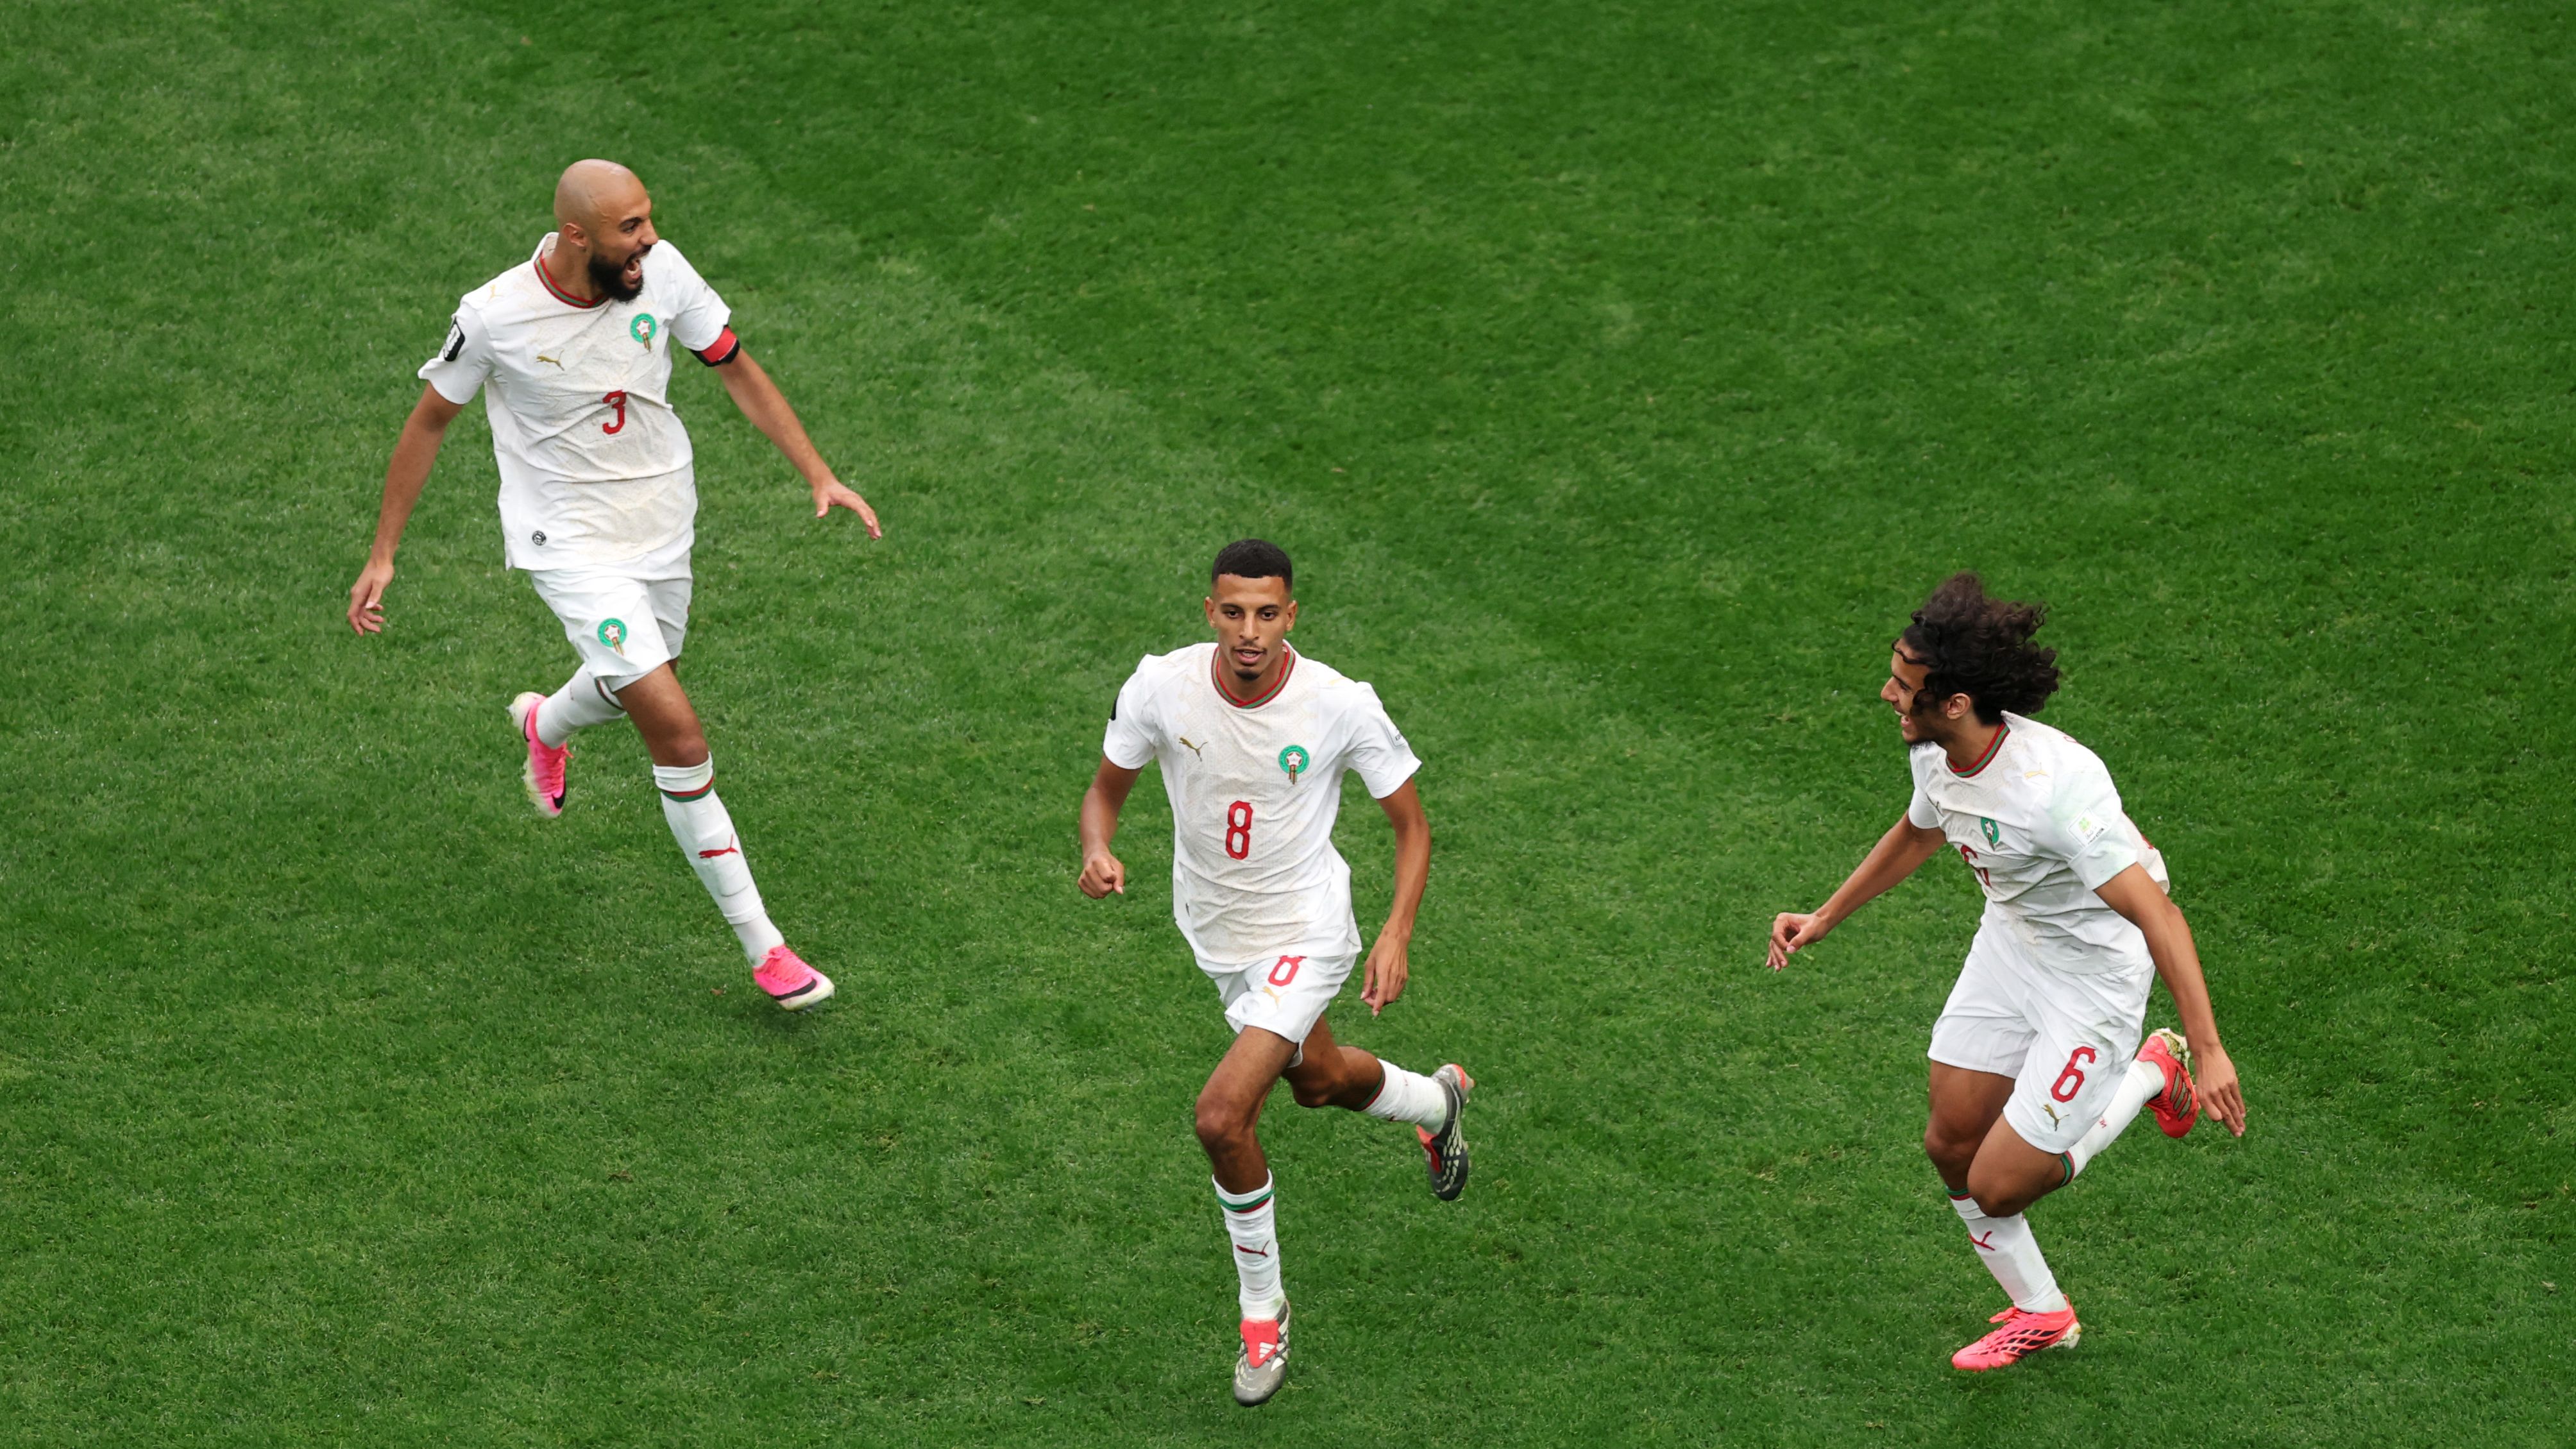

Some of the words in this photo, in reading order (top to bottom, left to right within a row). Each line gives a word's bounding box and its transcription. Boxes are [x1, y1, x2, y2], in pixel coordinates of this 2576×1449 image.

[602, 389, 627, 435] 3
[1224, 799, 1254, 861] 8
[2051, 1046, 2097, 1104] 6
